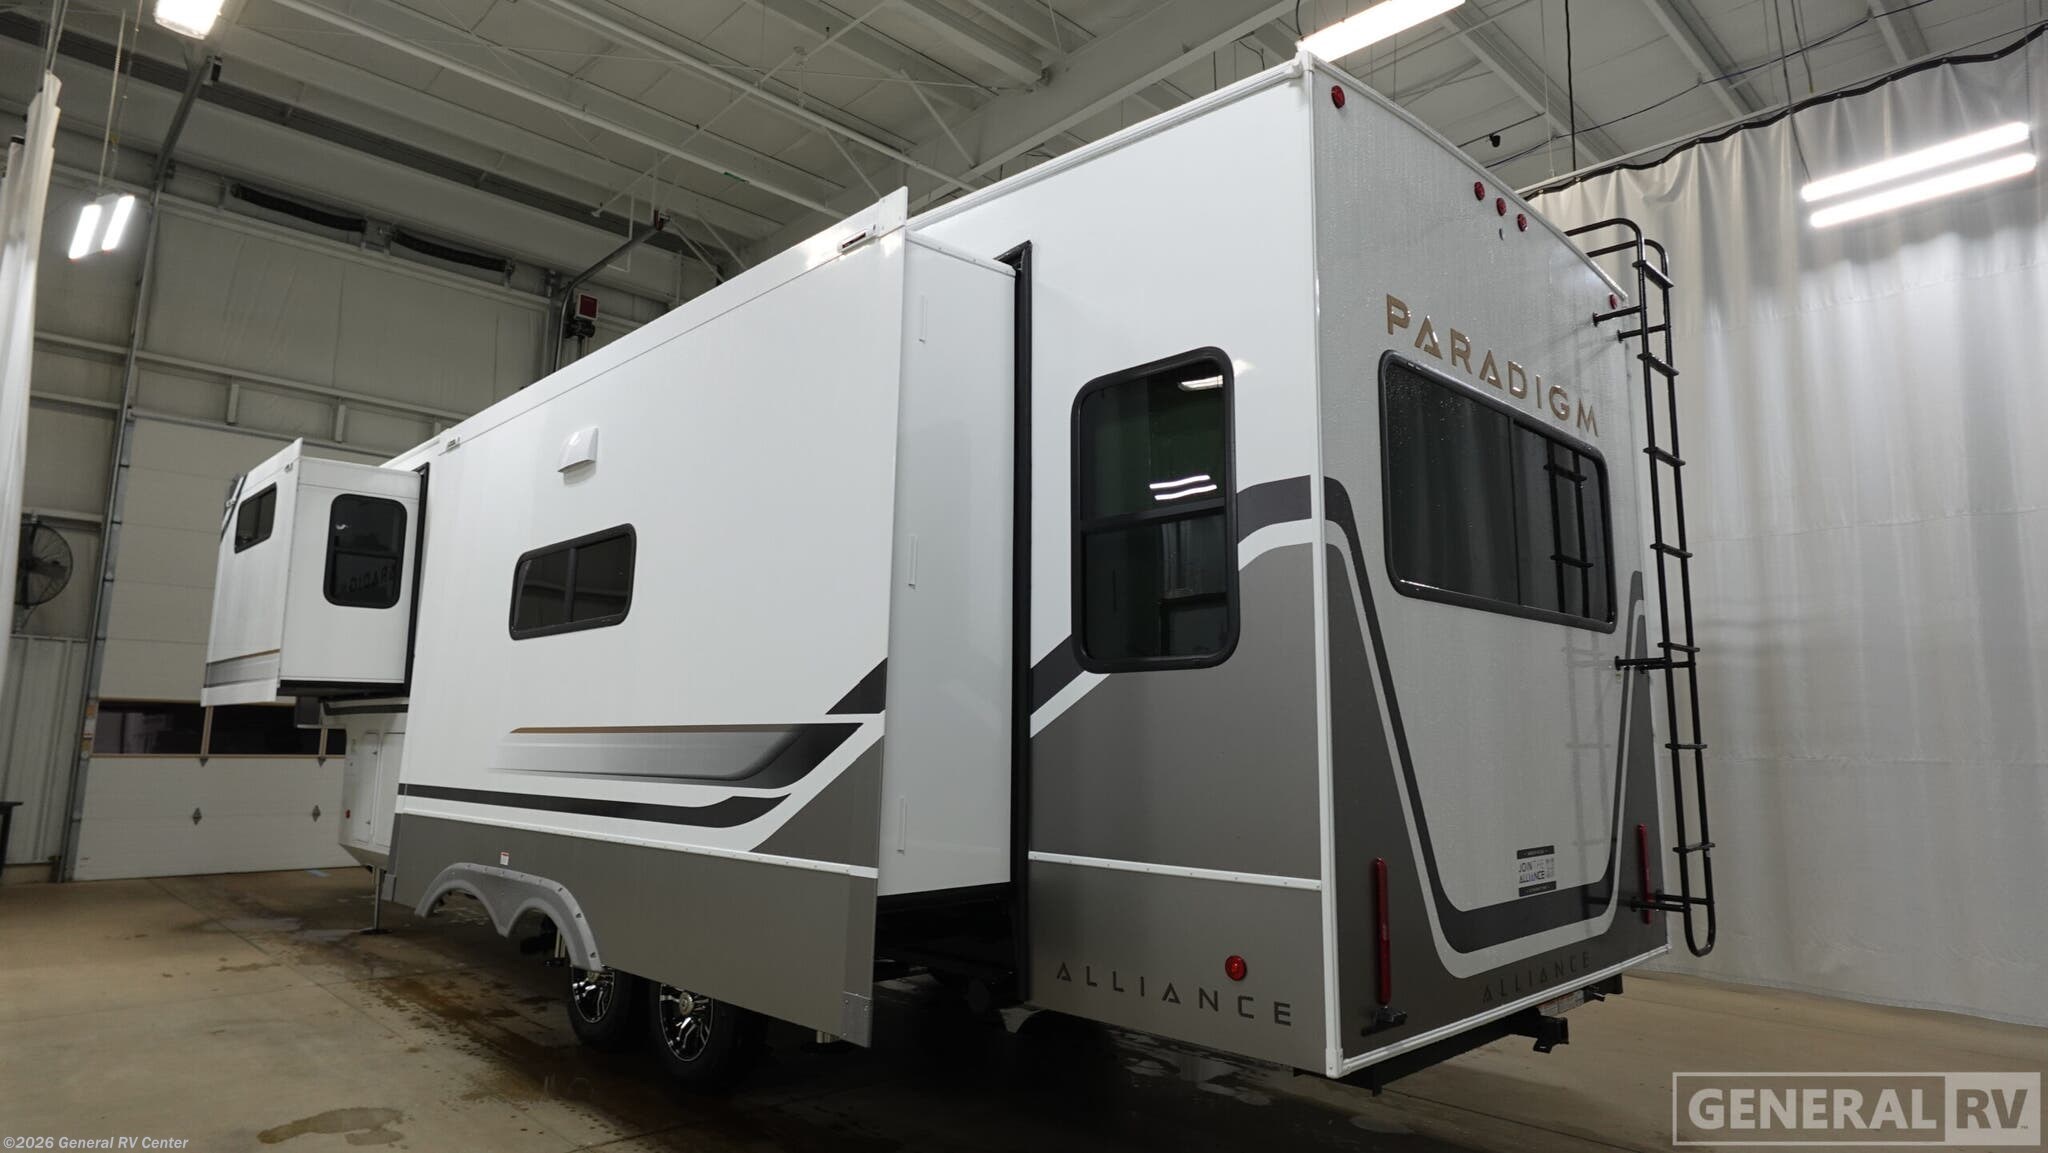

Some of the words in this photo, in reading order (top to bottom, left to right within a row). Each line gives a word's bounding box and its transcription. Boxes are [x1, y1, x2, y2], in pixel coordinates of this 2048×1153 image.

[1386, 294, 1599, 437] PARADIGM
[1056, 962, 1292, 1026] ALLIANCE
[1481, 951, 1591, 1004] ALLIANCE
